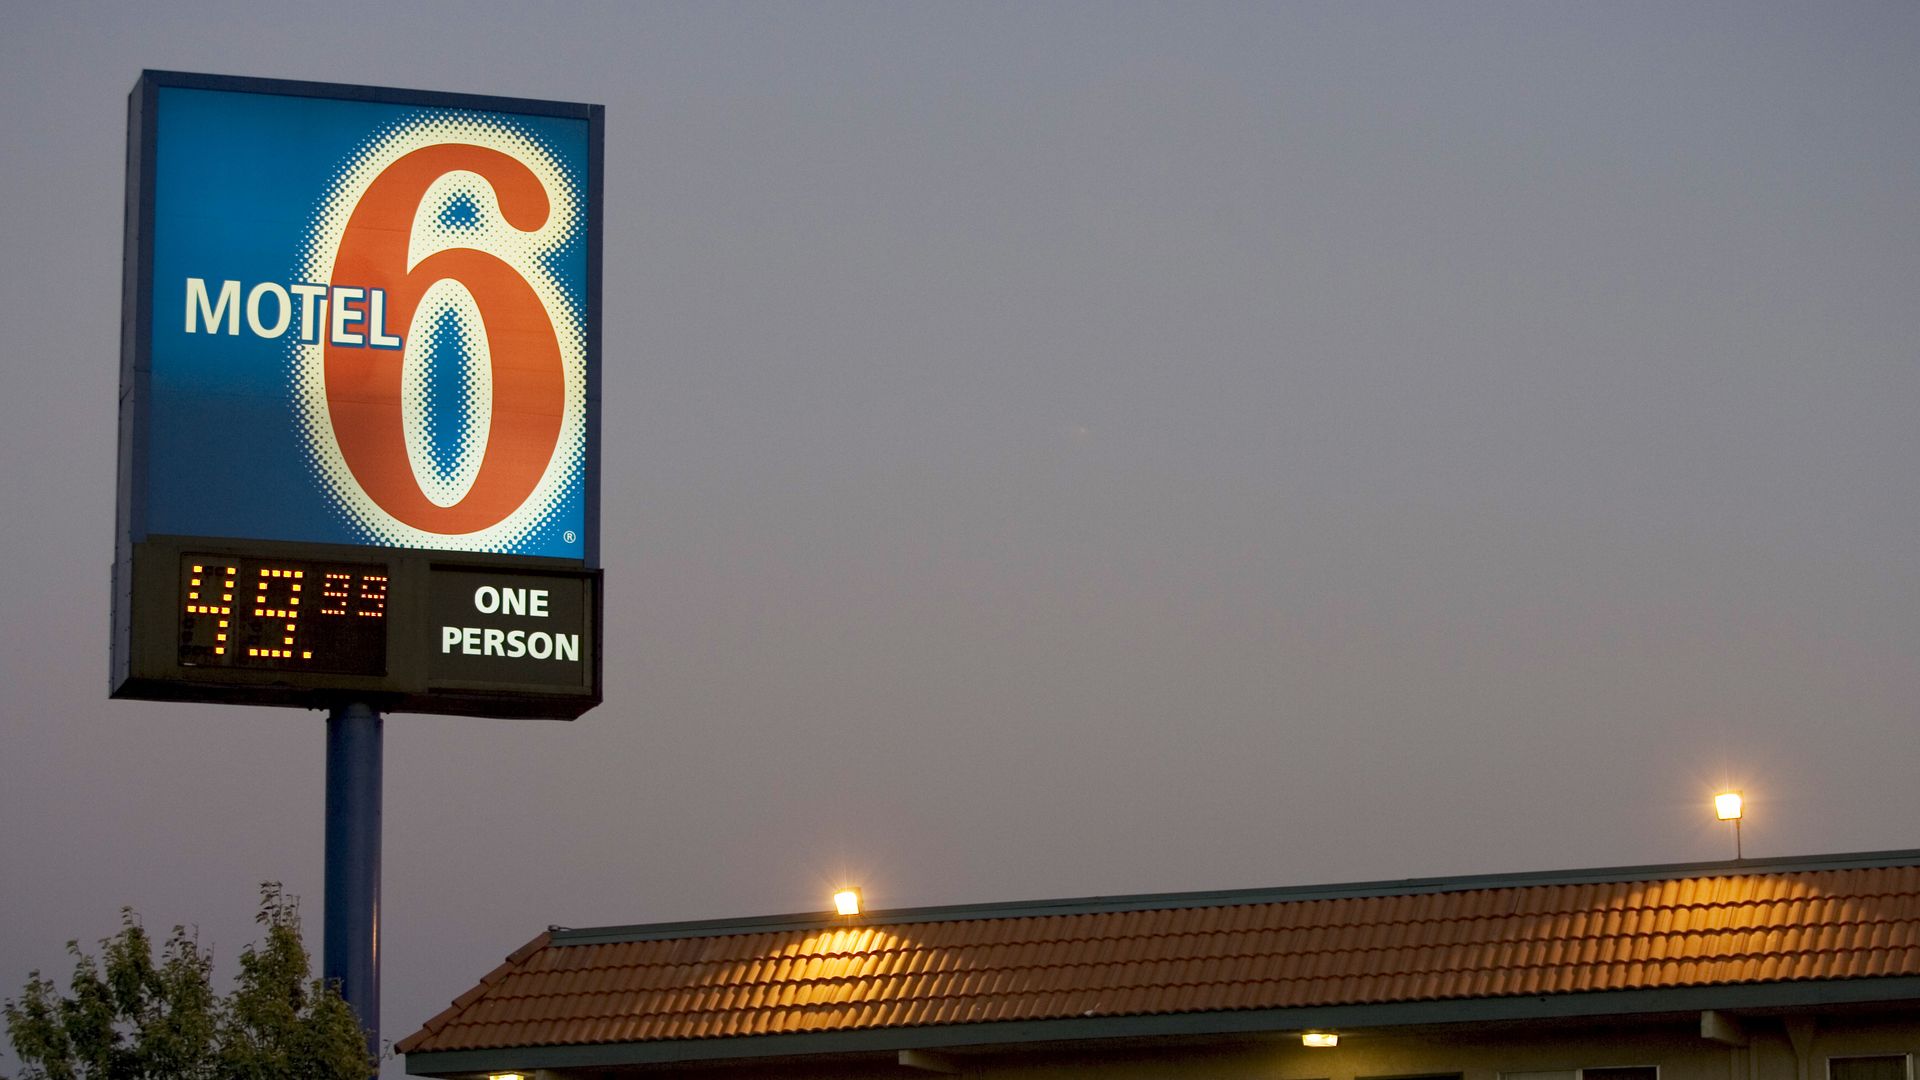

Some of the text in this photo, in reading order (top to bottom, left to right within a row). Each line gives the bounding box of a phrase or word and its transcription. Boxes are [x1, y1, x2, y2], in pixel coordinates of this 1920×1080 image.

[184, 142, 566, 536] MOTEL 6
[474, 585, 549, 617] ONE
[442, 626, 579, 662] PERSON
